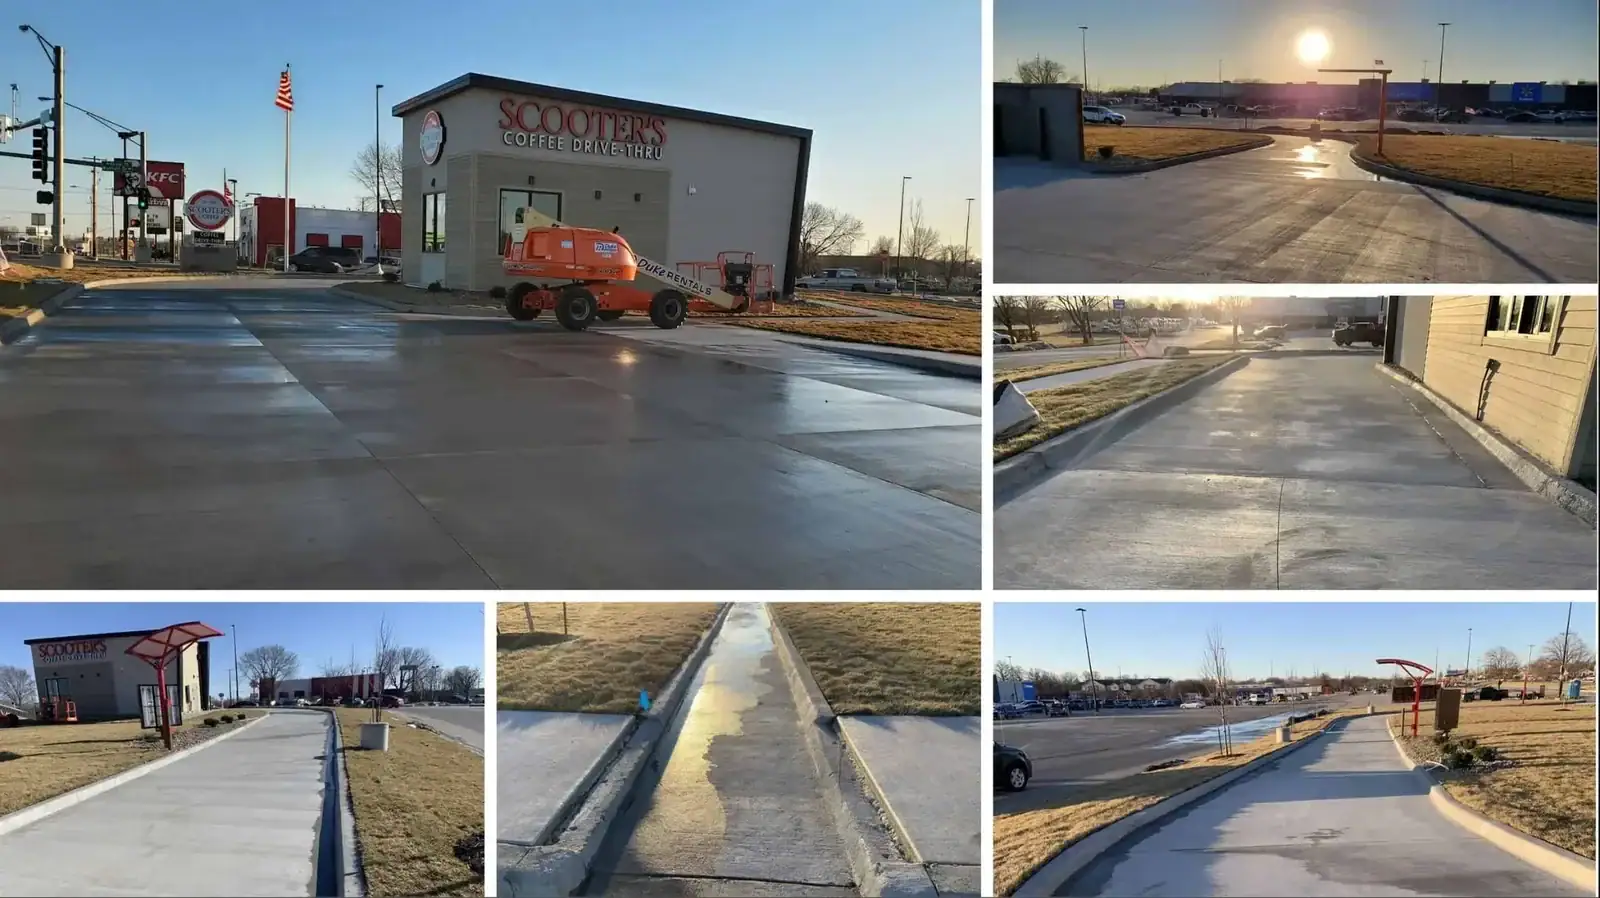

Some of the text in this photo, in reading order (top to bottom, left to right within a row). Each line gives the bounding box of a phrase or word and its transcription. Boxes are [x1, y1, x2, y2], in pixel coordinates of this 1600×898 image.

[498, 97, 667, 145] SCOOTER'S
[503, 131, 664, 161] COFFEE DRIVE-THRU
[147, 171, 180, 184] KFC
[666, 271, 712, 296] RENTALS
